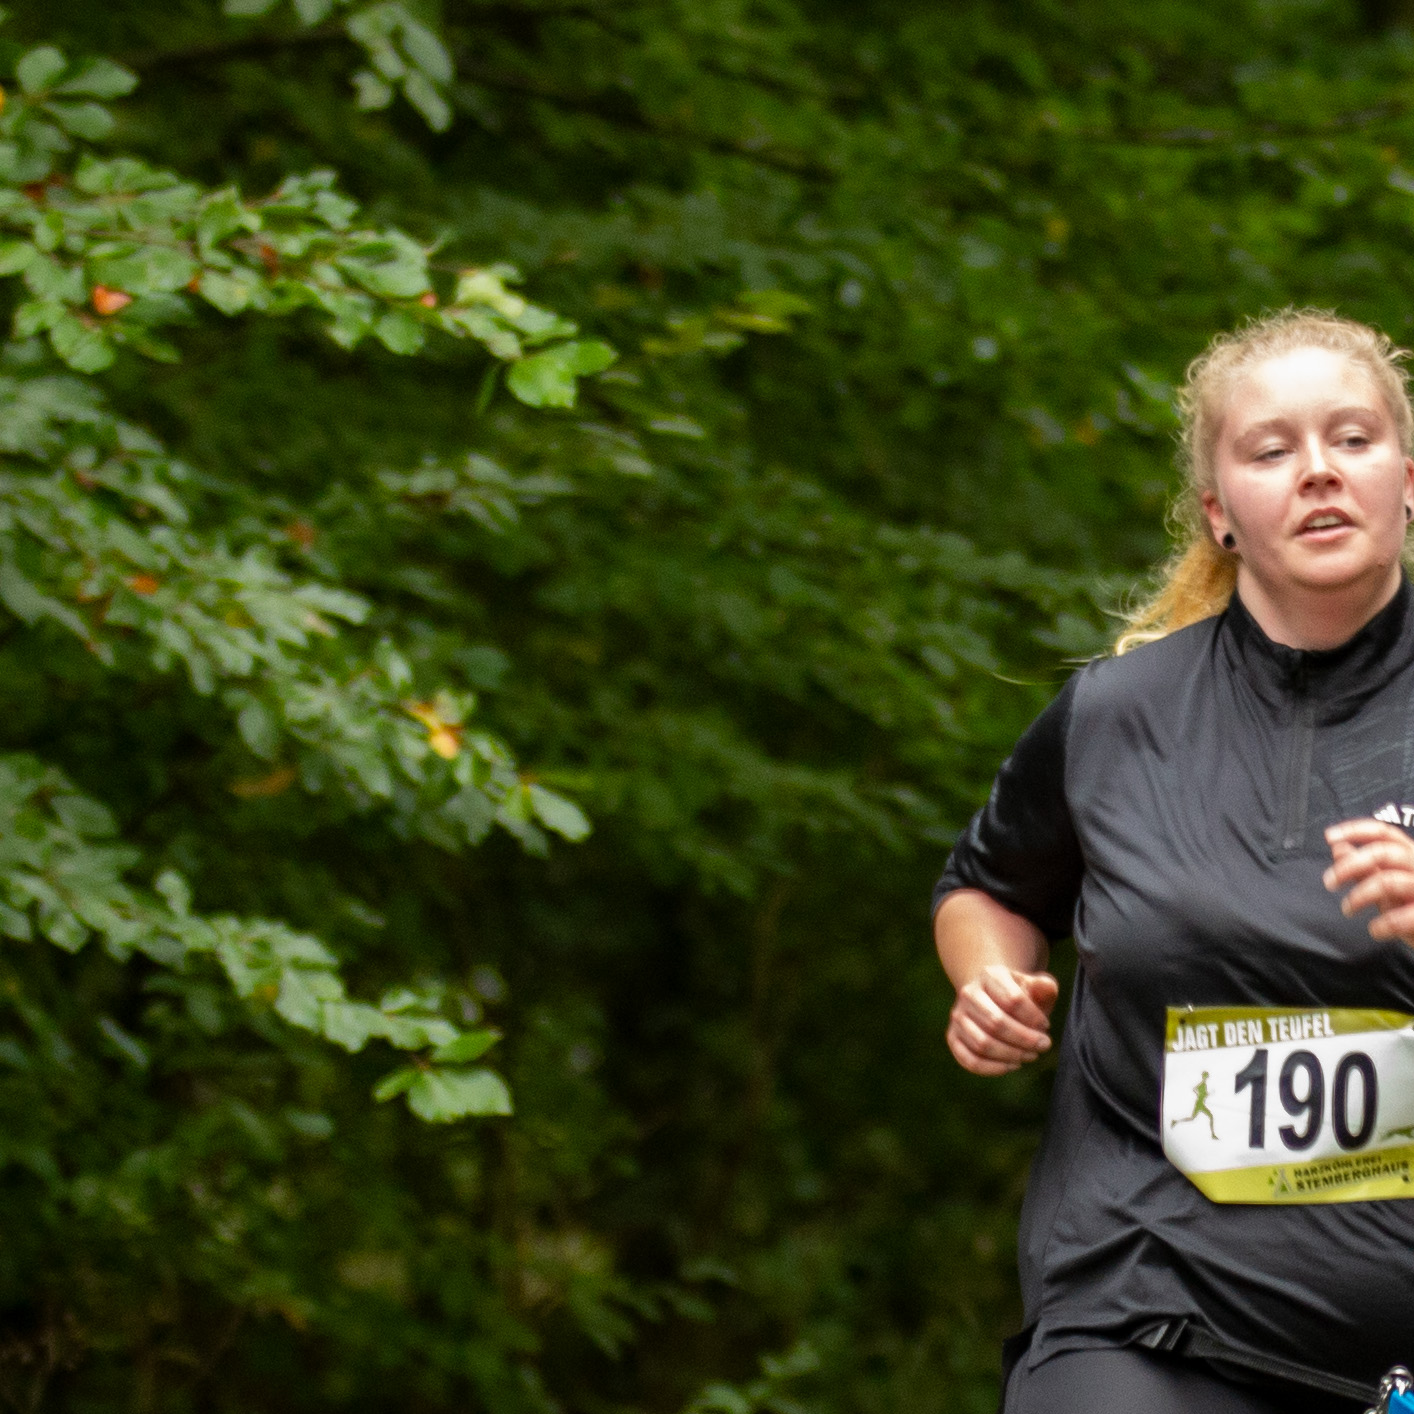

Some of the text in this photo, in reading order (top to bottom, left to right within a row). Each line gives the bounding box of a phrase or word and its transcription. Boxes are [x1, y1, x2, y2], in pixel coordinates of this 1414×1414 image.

[1172, 1012, 1335, 1051] JAGT DEN TEUFEL
[1234, 1048, 1379, 1151] 190
